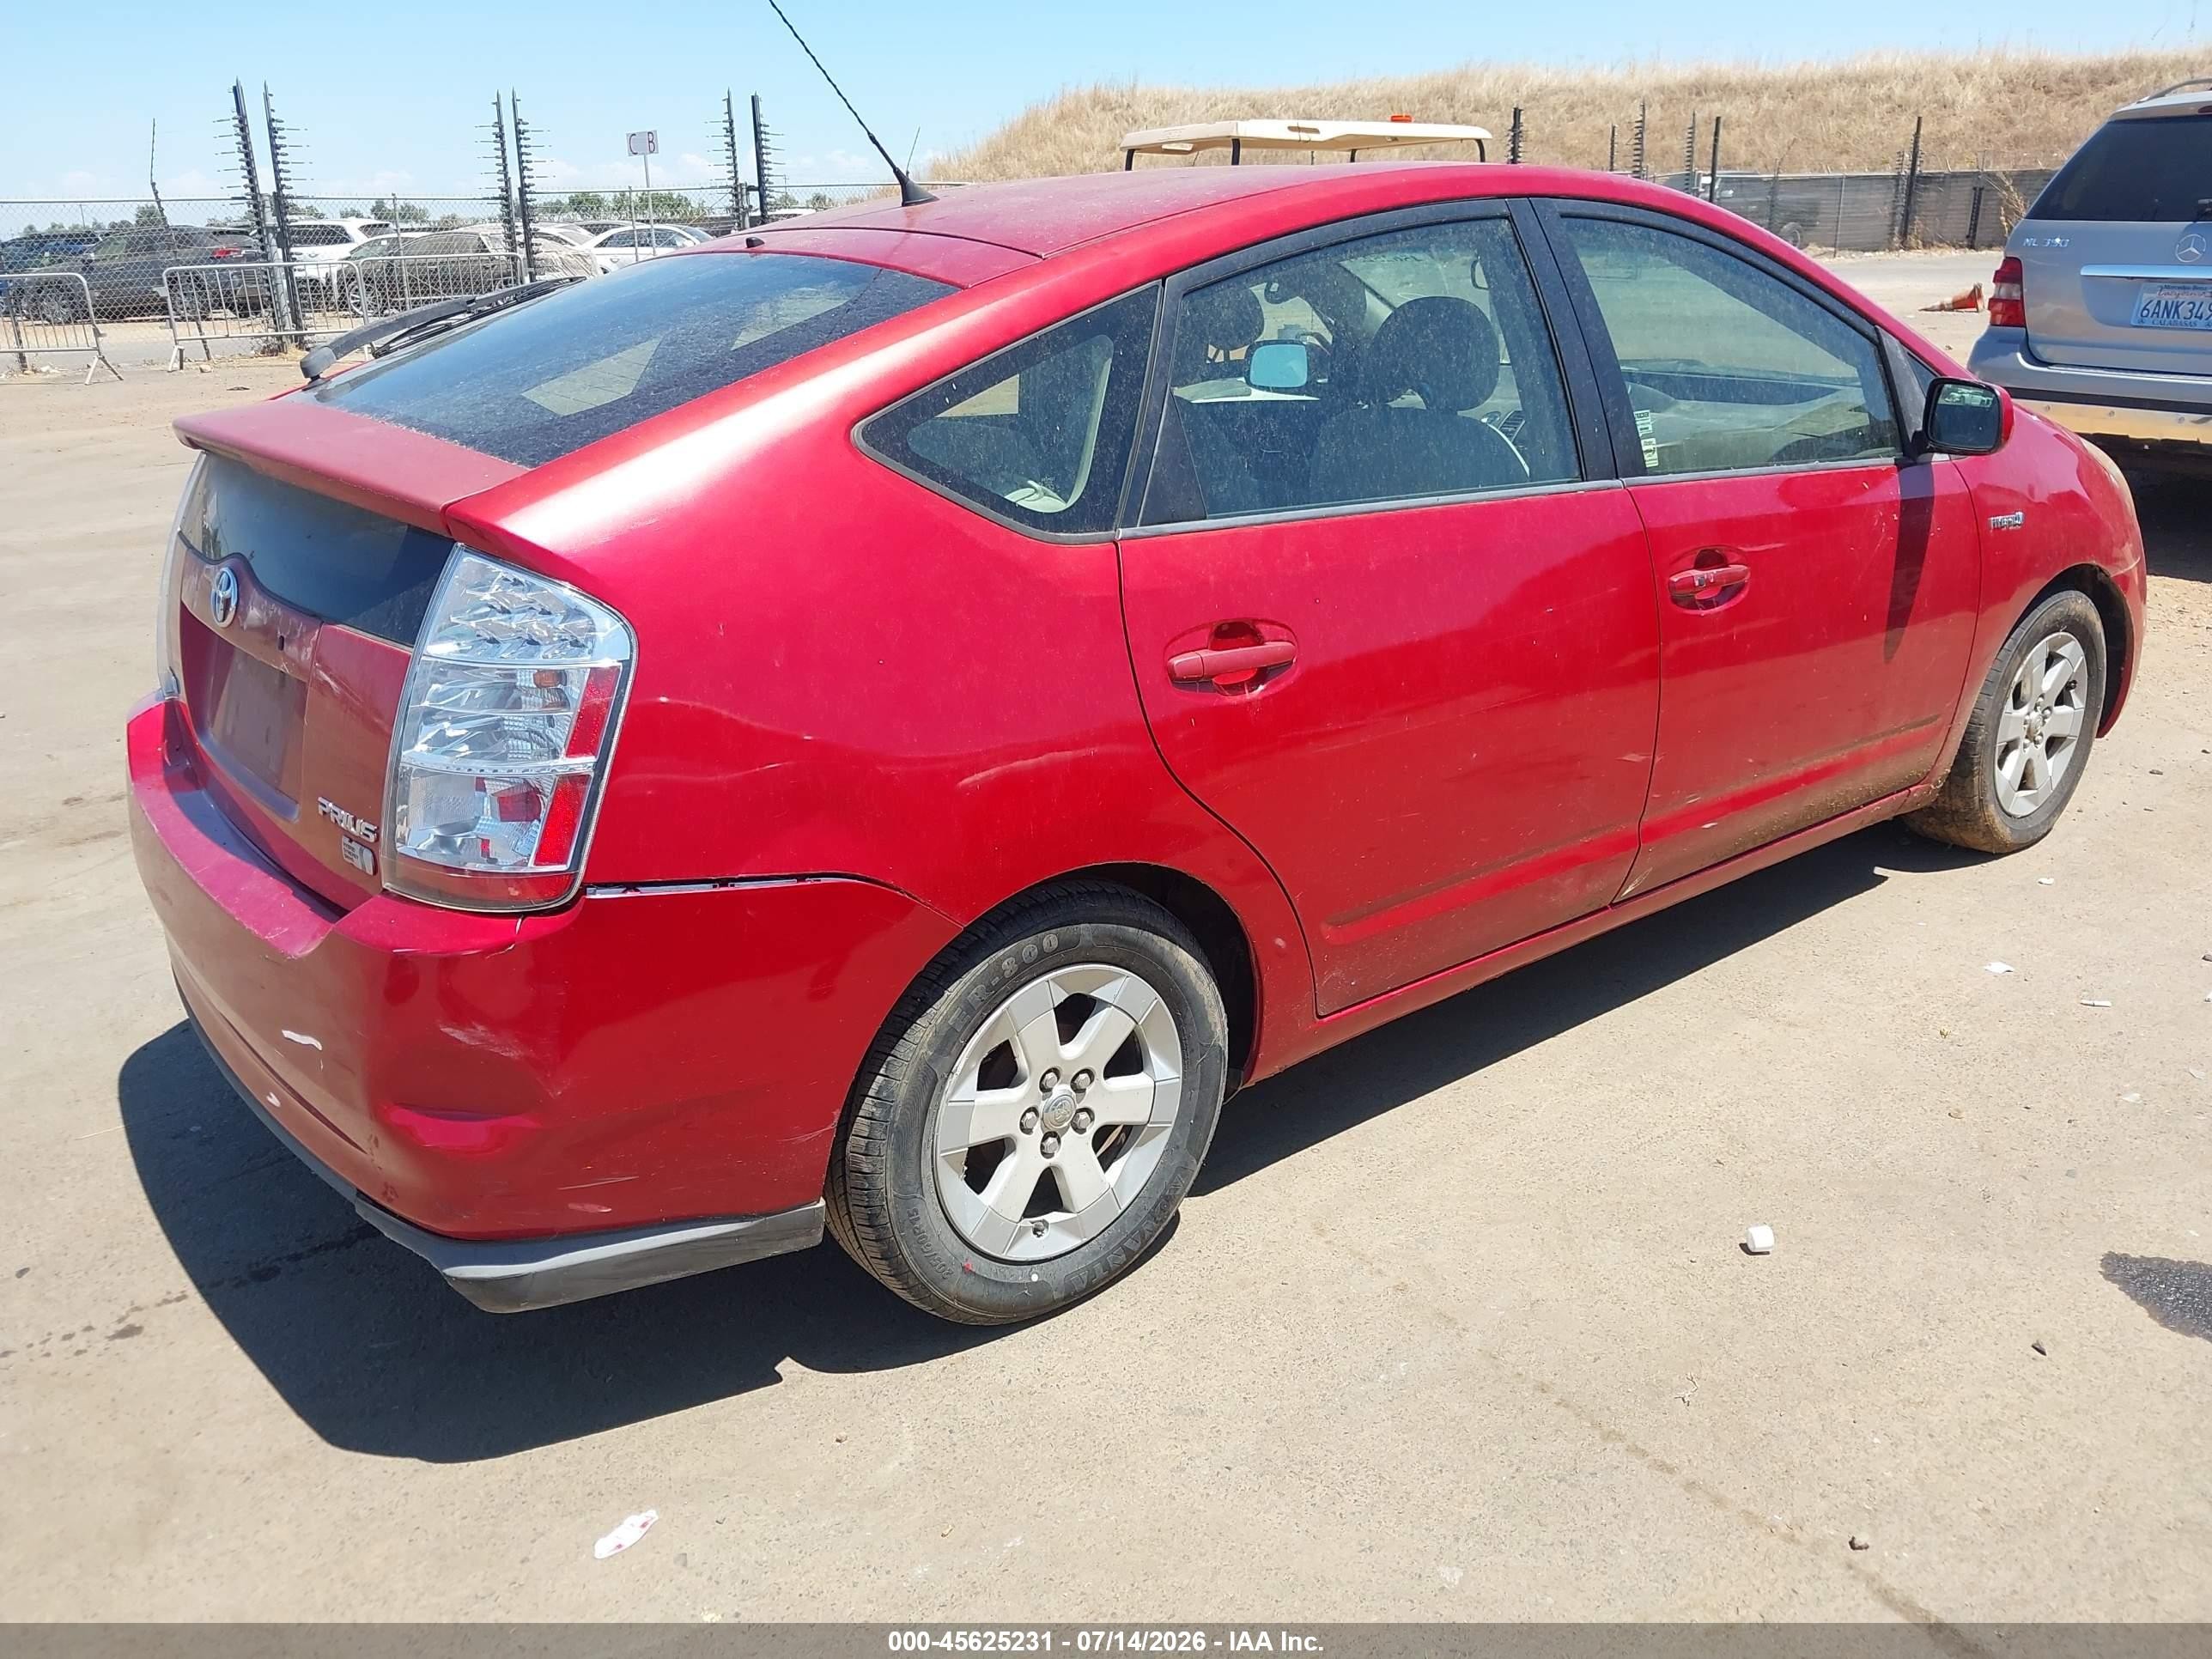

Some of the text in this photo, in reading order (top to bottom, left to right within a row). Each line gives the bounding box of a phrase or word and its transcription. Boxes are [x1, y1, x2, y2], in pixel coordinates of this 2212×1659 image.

[629, 131, 655, 155] C B
[318, 797, 377, 842] PRIUS
